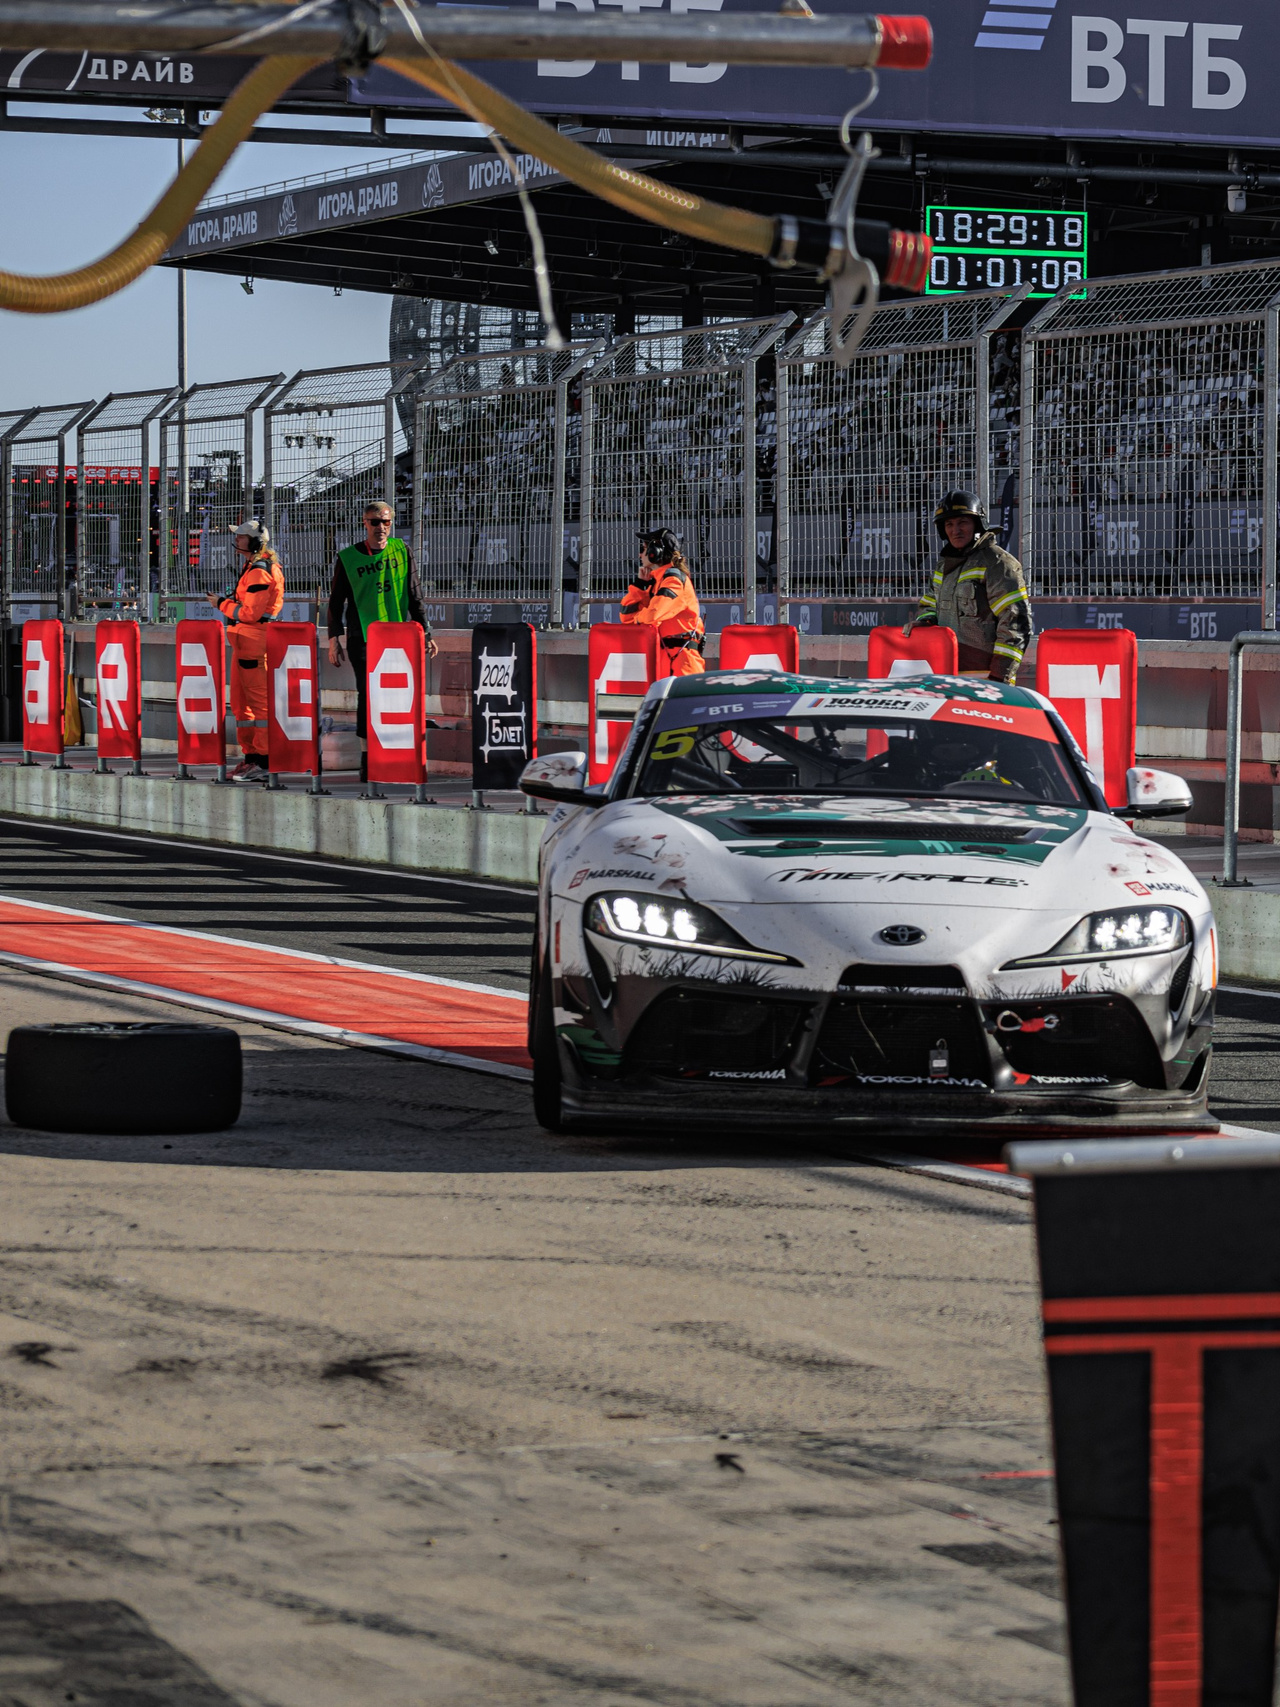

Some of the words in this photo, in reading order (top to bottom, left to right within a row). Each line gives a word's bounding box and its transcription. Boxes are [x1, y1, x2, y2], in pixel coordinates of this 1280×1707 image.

[87, 56, 194, 83] ДРАЙВ
[1070, 15, 1247, 111] ВТБ
[468, 159, 511, 190] ИГОРА
[318, 191, 355, 220] ИГОРА
[188, 217, 221, 246] ИГОРА
[935, 212, 1082, 247] 18:29:18
[930, 255, 1082, 289] 01:01:08
[861, 527, 892, 560] ВТБ
[1106, 520, 1141, 556] ВТБ
[357, 557, 398, 578] PHOTO
[376, 580, 391, 595] 35
[1190, 611, 1217, 639] ВТБ
[482, 664, 511, 688] 2026
[708, 703, 744, 715] ВТБ
[952, 707, 1013, 723] auto.ru
[651, 726, 699, 760] 5
[586, 869, 656, 880] MARSHALL
[709, 1069, 786, 1079] YOKOHAMA
[857, 1075, 987, 1087] YOKOHAMA
[1032, 1074, 1109, 1084] YOKOHAMA
